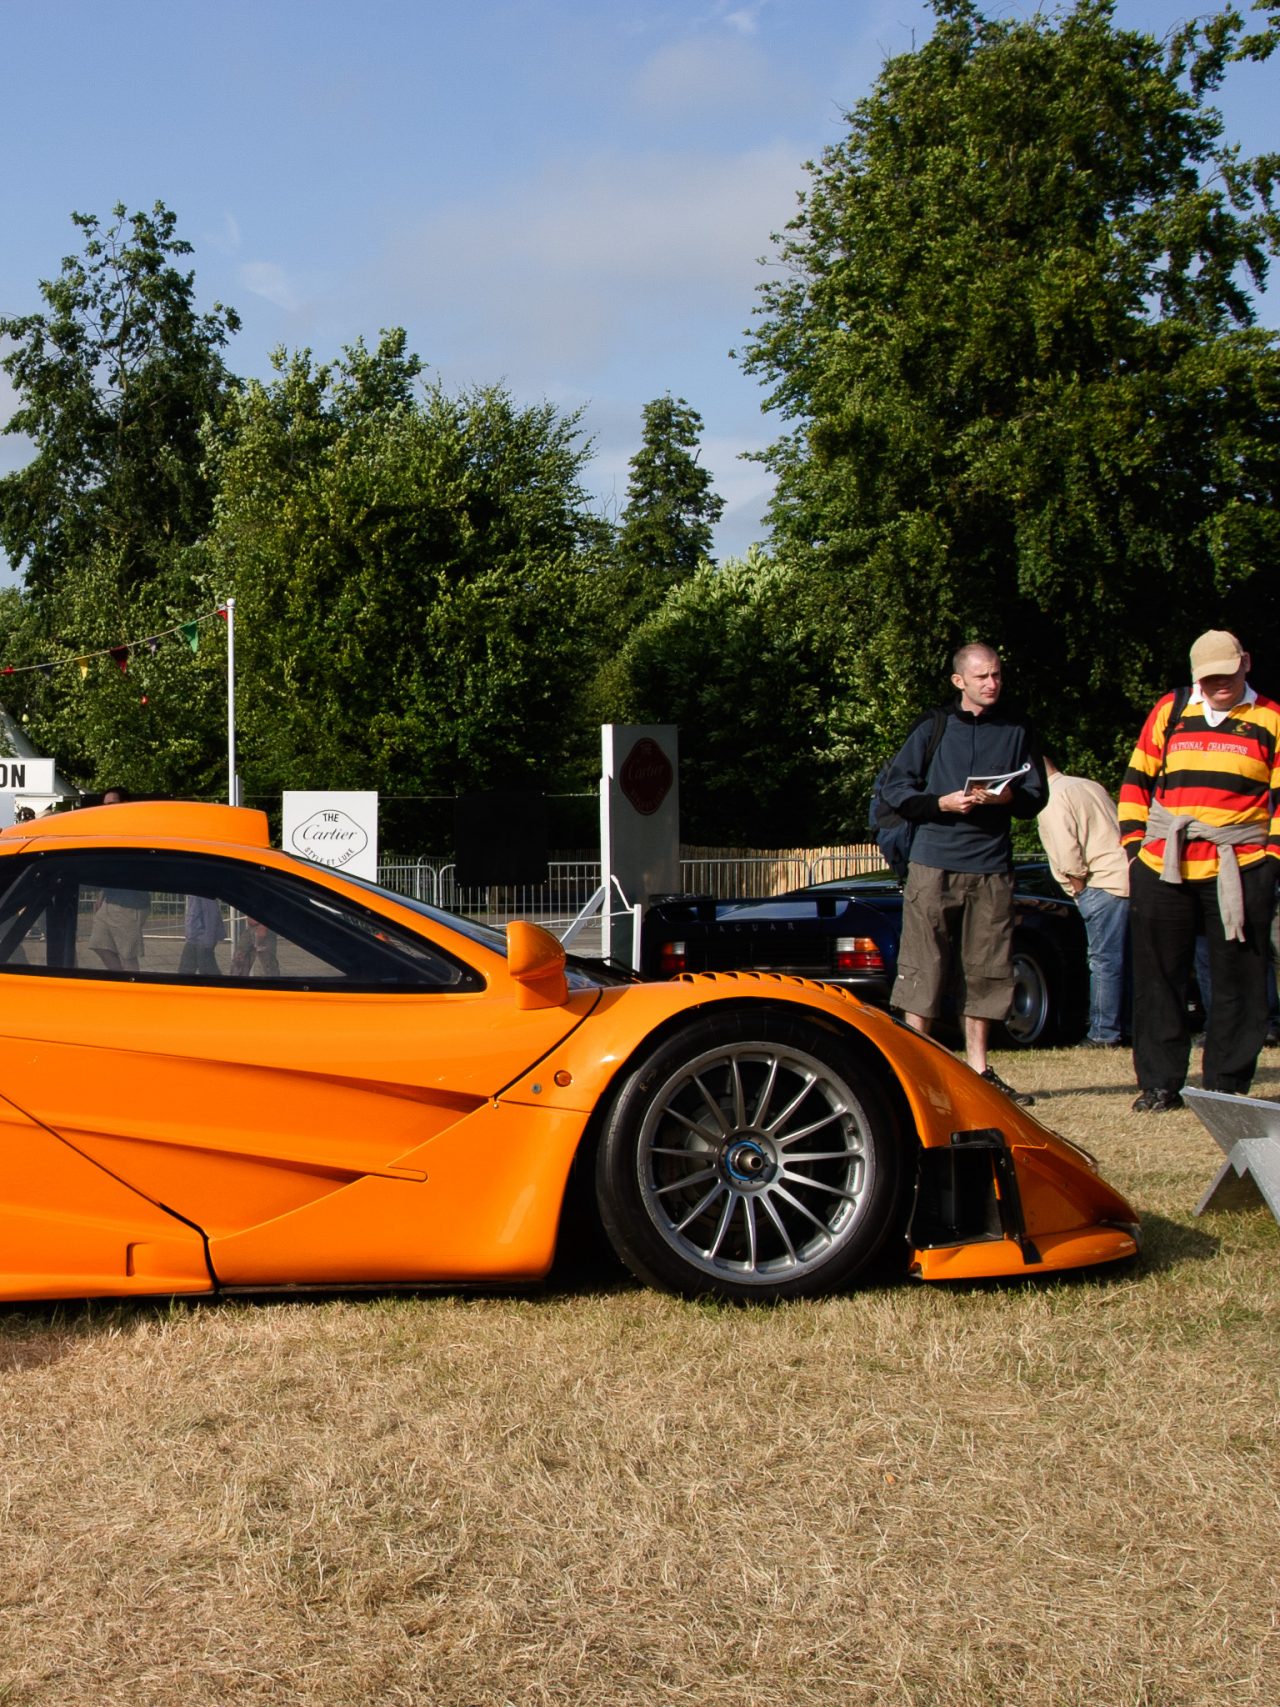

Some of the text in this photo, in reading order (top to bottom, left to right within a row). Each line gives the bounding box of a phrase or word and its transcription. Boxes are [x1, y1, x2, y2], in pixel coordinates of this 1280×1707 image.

[1170, 741, 1204, 751] NATIONAL
[322, 813, 340, 822] THE
[302, 824, 357, 840] Cartier
[304, 847, 355, 866] STYLE ET LUXE
